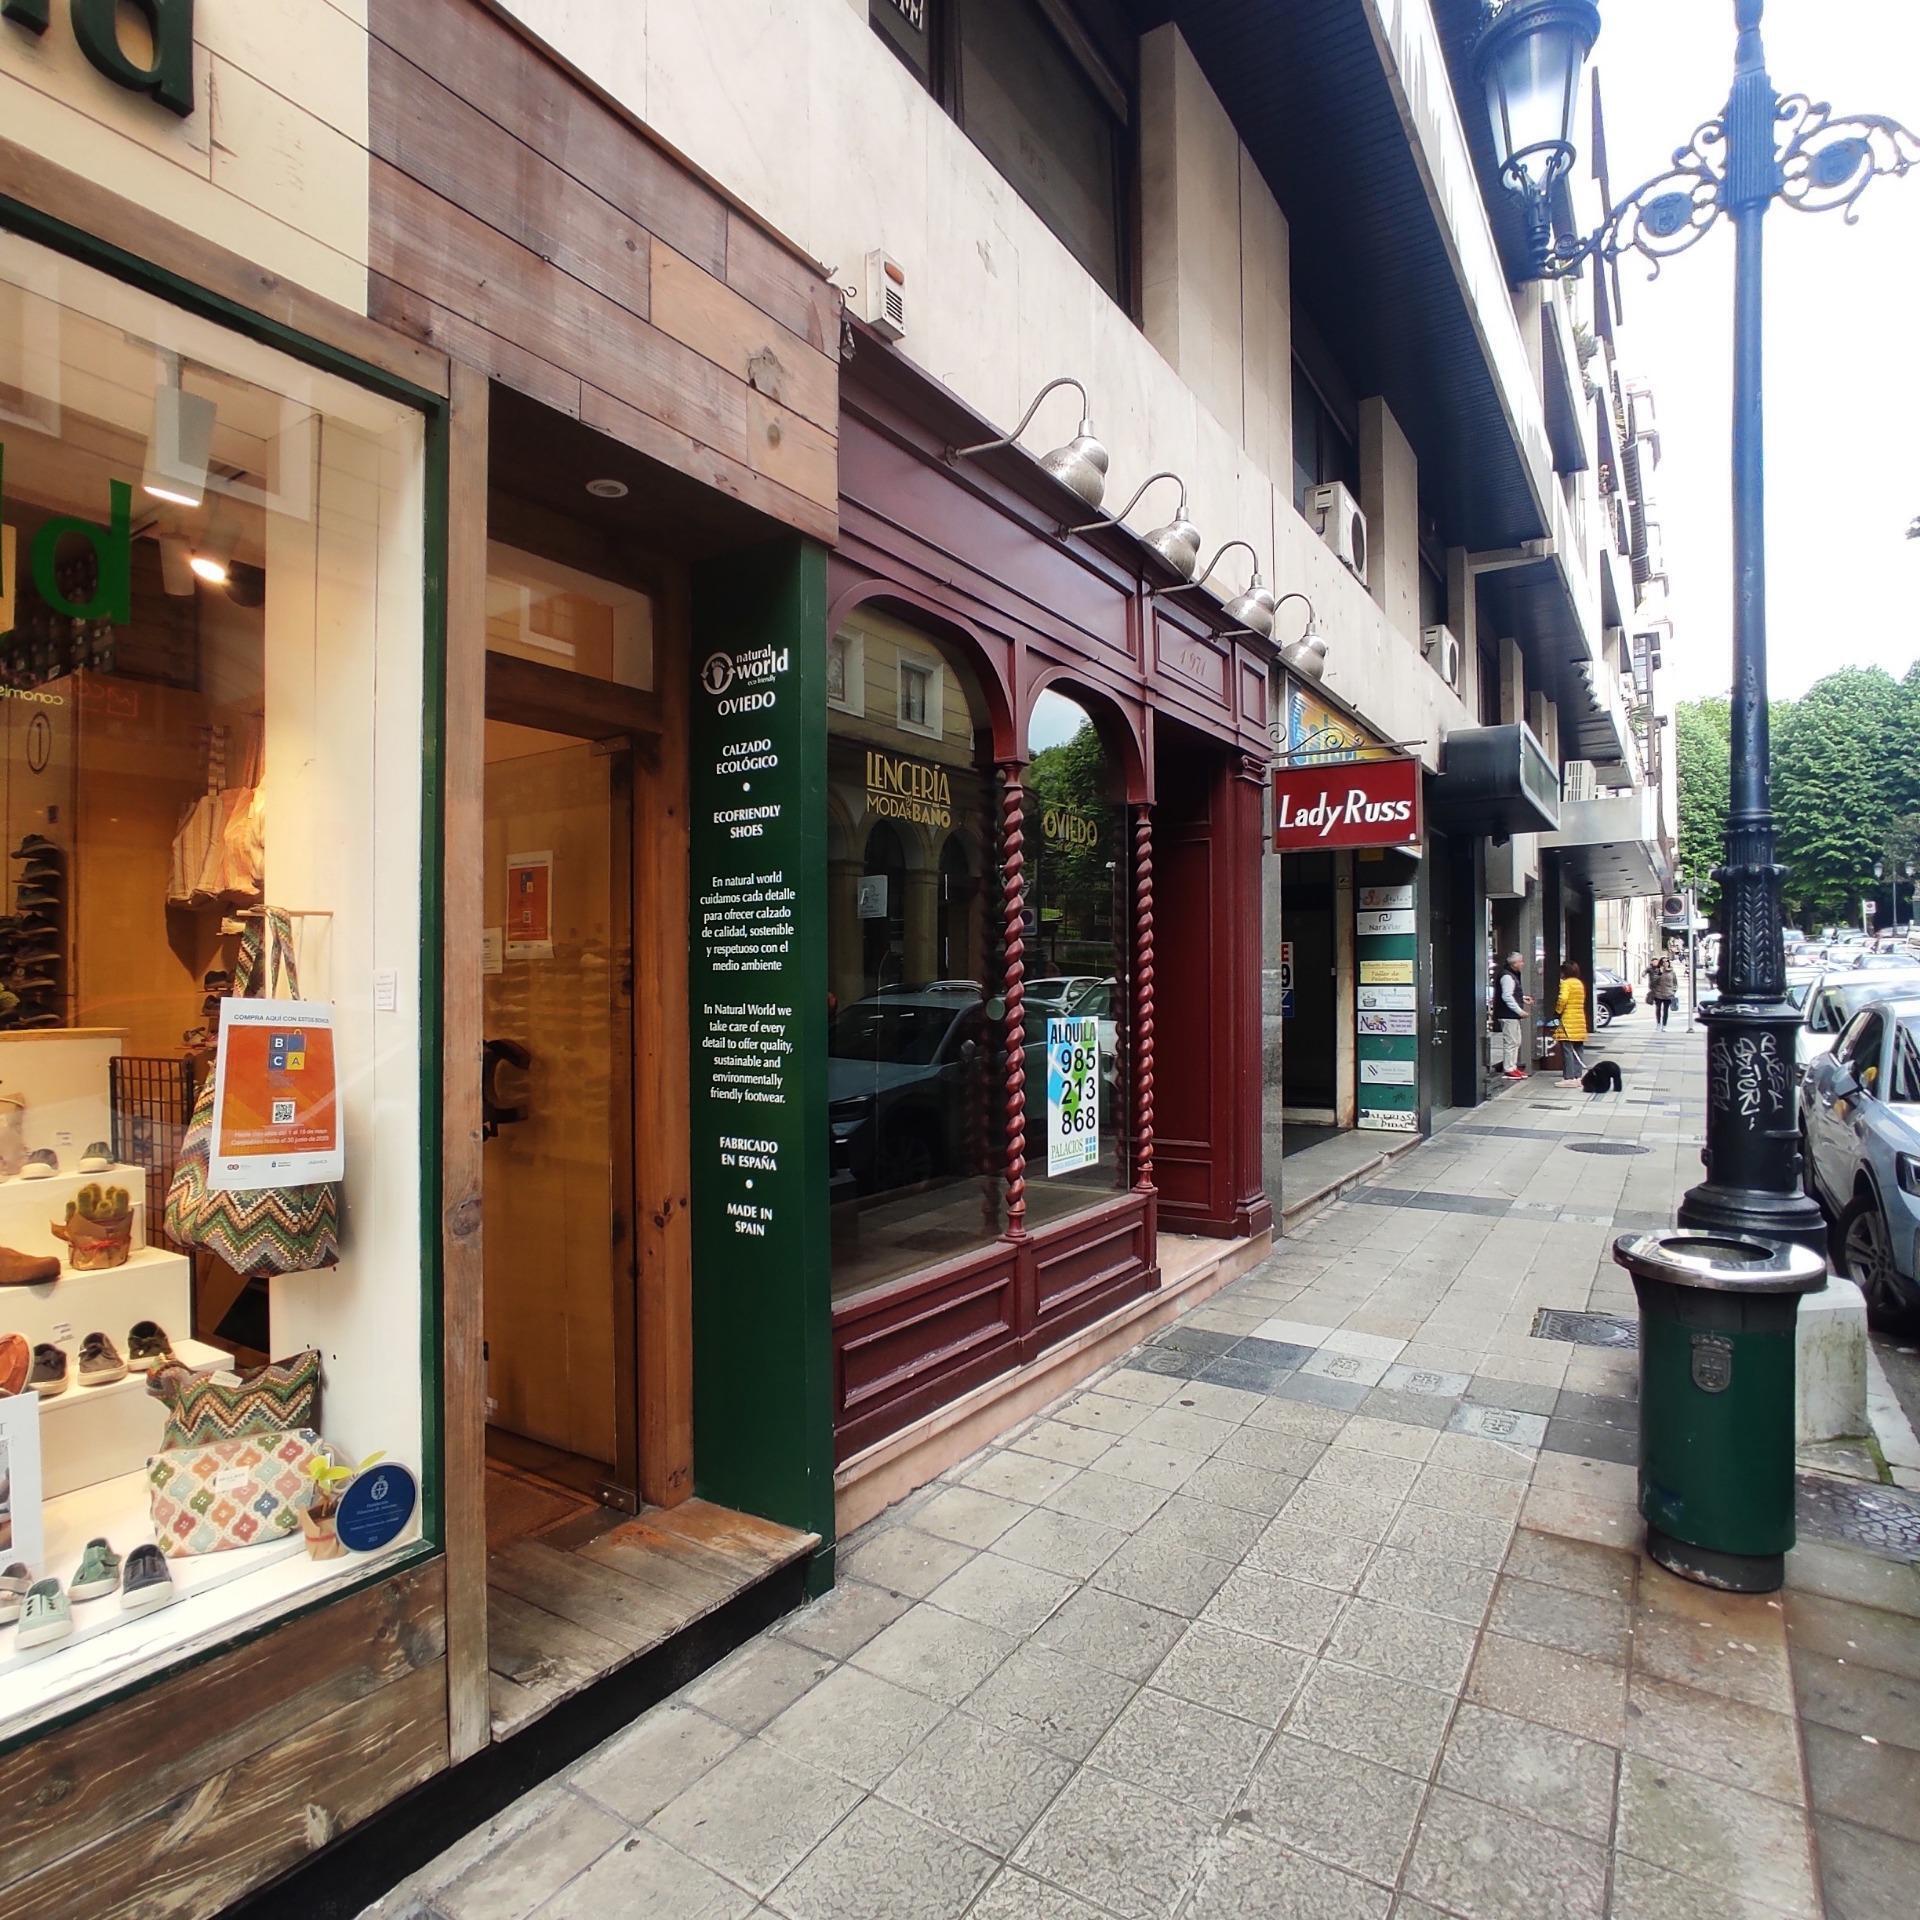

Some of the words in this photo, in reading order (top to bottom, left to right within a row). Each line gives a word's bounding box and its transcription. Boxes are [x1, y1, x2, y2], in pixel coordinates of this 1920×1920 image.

[736, 643, 771, 664] natural
[737, 647, 789, 680] world
[717, 691, 776, 716] OVIEDO
[722, 738, 772, 757] CALZADO
[716, 754, 779, 775] ECOLÓGICO
[866, 751, 951, 805] LENCERÍA
[713, 804, 782, 824] ECOFRIENDLY
[866, 793, 908, 820] MODA
[730, 823, 764, 839] SHOES
[1042, 809, 1098, 848] OVIEDO
[712, 876, 723, 887] En
[724, 872, 755, 887] natural
[756, 870, 782, 884] world
[700, 892, 741, 905] cuidamos
[742, 889, 763, 902] cada
[765, 887, 796, 901] detalle
[703, 912, 723, 925] para
[724, 908, 755, 920] ofrecer
[755, 905, 792, 919] calzado
[701, 926, 713, 938] de
[714, 924, 748, 938] calidad,
[749, 922, 795, 936] sostenible
[706, 945, 712, 958] y
[713, 944, 759, 957] respetuoso
[760, 944, 778, 953] con
[779, 940, 789, 953] el
[712, 958, 740, 971] medio
[740, 958, 783, 971] ambiente
[703, 1003, 713, 1014] In
[714, 1002, 746, 1015] Natural
[747, 1003, 776, 1016] World
[777, 1007, 793, 1016] we
[709, 1019, 728, 1032] take
[728, 1023, 748, 1032] care
[749, 1020, 760, 1032] of
[760, 1024, 786, 1037] every
[1050, 1022, 1097, 1045] ALQUILA
[274, 1038, 284, 1048] B
[702, 1036, 726, 1049] detail
[727, 1039, 737, 1049] to
[738, 1037, 759, 1050] offer
[760, 1038, 794, 1054] quality,
[273, 1056, 284, 1066] C
[291, 1057, 301, 1065] A
[713, 1054, 762, 1067] sustainable
[763, 1055, 782, 1068] and
[1061, 1047, 1097, 1074] 985
[712, 1071, 784, 1089] environmentally
[710, 1086, 743, 1103] friendly
[744, 1089, 786, 1103] footwear.
[1061, 1077, 1097, 1105] 213
[1061, 1106, 1097, 1135] 868
[719, 1136, 779, 1154] FABRICADO
[1051, 1138, 1084, 1159] PALACIOS
[721, 1153, 735, 1166] EN
[738, 1155, 777, 1171] ESPAÑA
[726, 1202, 757, 1218] MADE
[760, 1207, 773, 1220] IN
[735, 1220, 765, 1236] SPAIN
